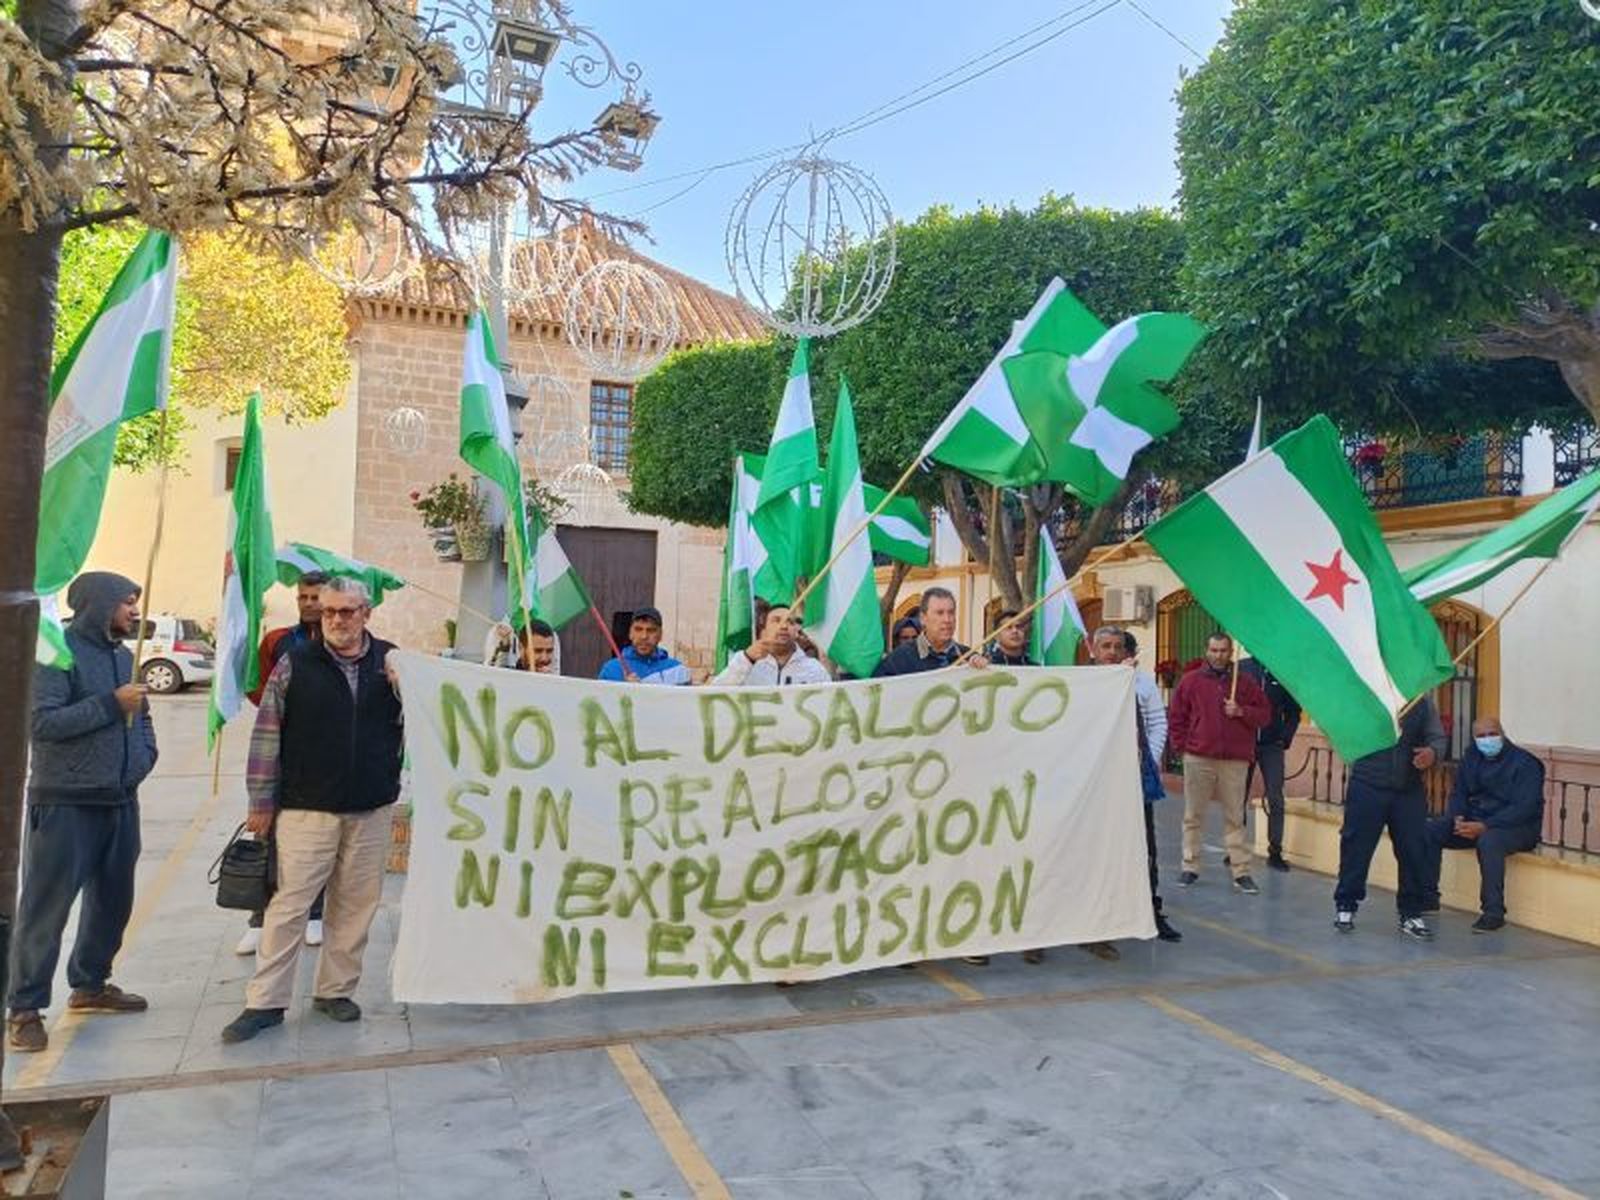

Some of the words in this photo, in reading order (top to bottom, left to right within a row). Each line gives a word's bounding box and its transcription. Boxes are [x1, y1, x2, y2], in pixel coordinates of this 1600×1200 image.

[438, 681, 556, 777] NO
[579, 696, 680, 768] AL
[697, 671, 1070, 764] DESALOJO
[446, 780, 574, 853] SIN
[617, 750, 951, 861] REALOJO
[454, 847, 534, 919] NI
[555, 769, 1038, 922] EXPLOTACION
[541, 922, 608, 988] NI
[645, 857, 1034, 982] EXCLUSION
